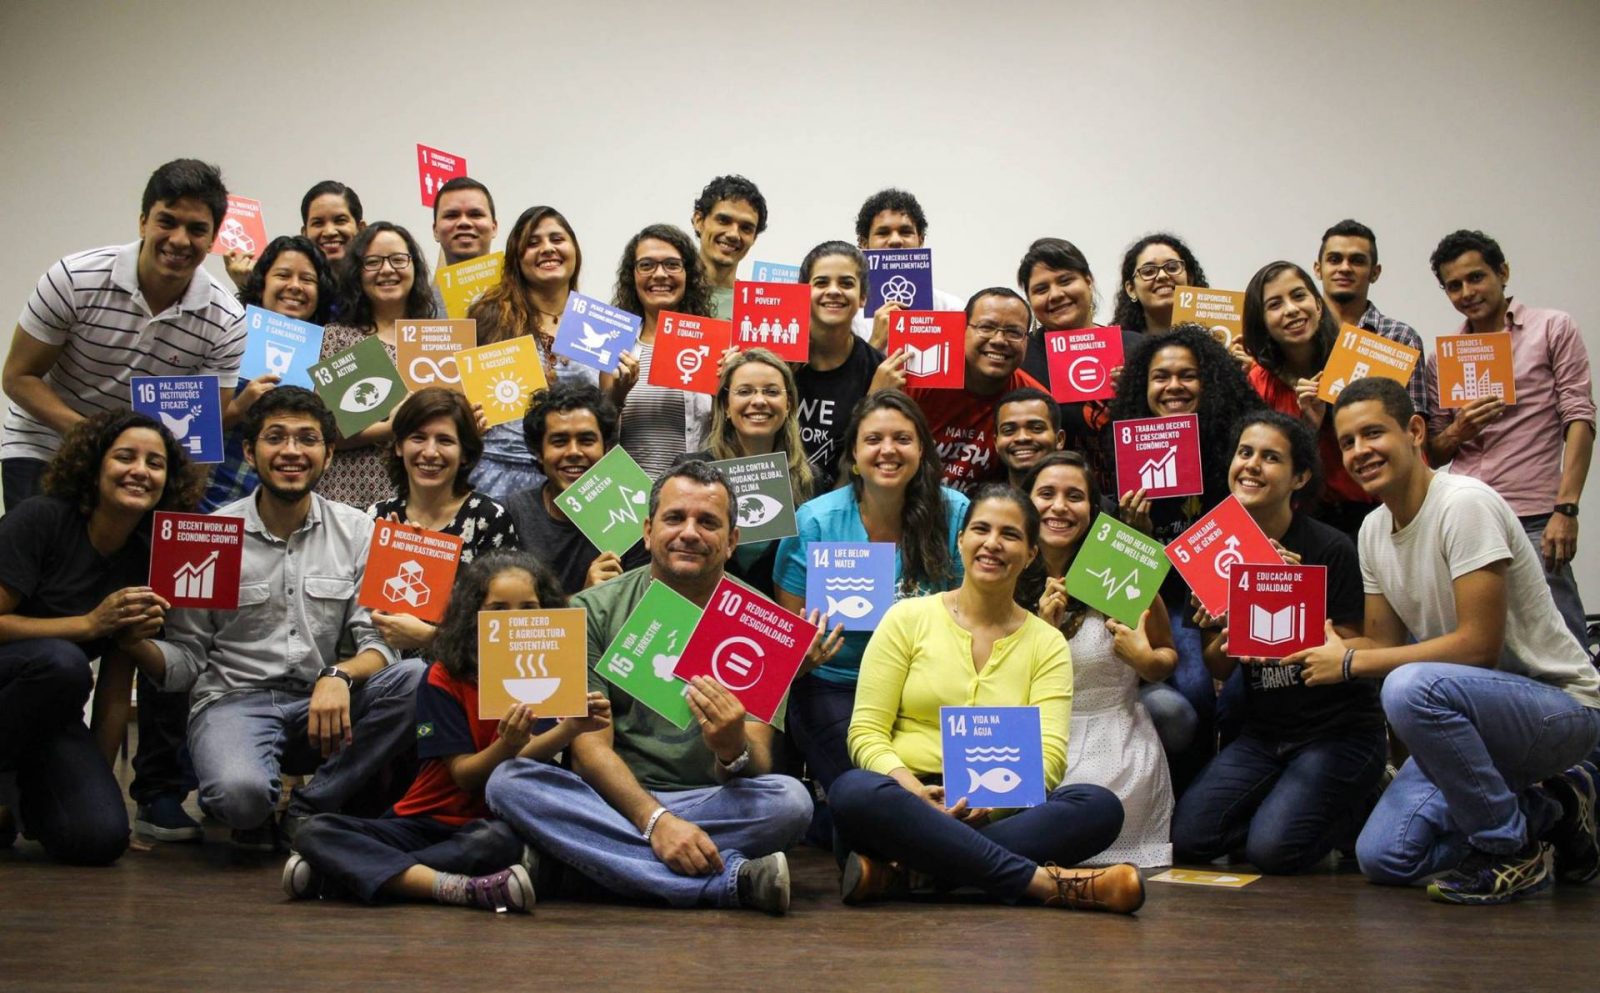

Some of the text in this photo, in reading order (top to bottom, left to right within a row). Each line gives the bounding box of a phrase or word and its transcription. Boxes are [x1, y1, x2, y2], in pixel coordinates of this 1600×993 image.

[422, 150, 428, 164] 1
[868, 255, 880, 270] 17
[882, 253, 929, 262] PARCERIAS E MEIOS
[882, 261, 930, 270] DE IMPLEMENTAÇÃO
[443, 272, 451, 288] 7
[760, 267, 767, 282] 6
[742, 287, 748, 304] 1
[755, 297, 781, 305] POVERTY
[1179, 292, 1193, 308] 12
[1197, 293, 1232, 303] RESPONSIBLE
[572, 298, 587, 314] 16
[1196, 302, 1235, 312] CONSUMPTION
[252, 313, 261, 329] 6
[910, 317, 935, 325] QUALITY
[1195, 310, 1241, 321] AND PRODUCTION
[449, 325, 453, 333] E
[664, 317, 673, 335] 5
[678, 320, 700, 330] GENDER
[896, 316, 905, 333] 4
[909, 325, 941, 334] EDUCATION
[401, 326, 417, 342] 12
[421, 334, 451, 343] PRODUÇÃO
[677, 328, 704, 339] EQUALITY
[1069, 333, 1095, 343] REDUCED
[1342, 331, 1358, 350] 11
[421, 343, 462, 351] RESPONSÁVEIS
[1050, 336, 1066, 352] 10
[1070, 341, 1106, 351] INEQUALITIES
[1360, 336, 1414, 363] SUSTAINABLE CITIES
[1441, 341, 1453, 358] 11
[1456, 339, 1478, 347] CIDADES
[1456, 345, 1494, 354] COMUNIDADES
[331, 352, 356, 370] CLIMATE
[463, 356, 472, 374] 7
[1356, 345, 1409, 371] AND COMMUNITIES
[314, 367, 333, 386] 13
[336, 363, 358, 378] ACTION
[138, 384, 156, 403] 16
[160, 382, 173, 391] PAZ,
[174, 382, 198, 391] JUSTIÇA
[160, 390, 200, 400] INSTITUIÇÕES
[161, 400, 189, 409] EFICAZES
[945, 427, 984, 441] MAKE A
[1135, 421, 1191, 432] TRABALHO DECENTE
[799, 427, 829, 443] ORK
[1122, 427, 1132, 444] 8
[1135, 431, 1180, 442] E CRESCIMENTO
[1136, 441, 1170, 451] ECONÔMICO
[729, 465, 745, 476] AÇÃO
[746, 462, 769, 472] CONTRA
[941, 463, 974, 478] AKE A
[730, 470, 783, 484] MUDANÇA GLOBAL
[578, 480, 594, 495] SAÚDE
[741, 483, 760, 492] CLIMA
[566, 496, 582, 512] 3
[162, 520, 172, 540] 8
[178, 521, 238, 533] DECENT WORK AND
[1097, 523, 1111, 541] 3
[1188, 519, 1217, 546] IGUALDADE
[177, 532, 238, 544] ECONOMIC GROWTH
[380, 527, 391, 546] 9
[394, 530, 458, 550] INDUSTRY, INNOVATION
[1116, 530, 1157, 556] GOOD HEALTH
[1193, 528, 1223, 554] DE GÊNERO
[391, 540, 455, 561] AND INFRASTRUCTURE
[834, 549, 870, 558] LIFE BELOW
[1111, 540, 1159, 570] AND WELL-BEING
[1174, 545, 1190, 563] 5
[813, 549, 829, 568] 14
[834, 559, 856, 568] WATER
[1238, 571, 1249, 591] 4
[1256, 571, 1303, 582] EDUCAÇÃO DE
[1256, 583, 1293, 592] QUALIDADE
[718, 589, 742, 617] 10
[509, 616, 550, 626] FOME ZERO
[745, 601, 794, 633] REDUÇÃO DAS
[489, 619, 500, 643] 2
[509, 628, 566, 638] E AGRICULTURA
[739, 612, 796, 648] DESIGUALDADES
[509, 639, 560, 650] SUSTENTÁVEL
[621, 633, 639, 650] VIDA
[632, 619, 662, 657] TERRESTRE
[608, 653, 634, 678] 15
[1261, 665, 1299, 688] BRAVE
[948, 715, 967, 736] 14
[972, 715, 1000, 724] VIDA NA
[973, 725, 992, 736] ÁGUA
